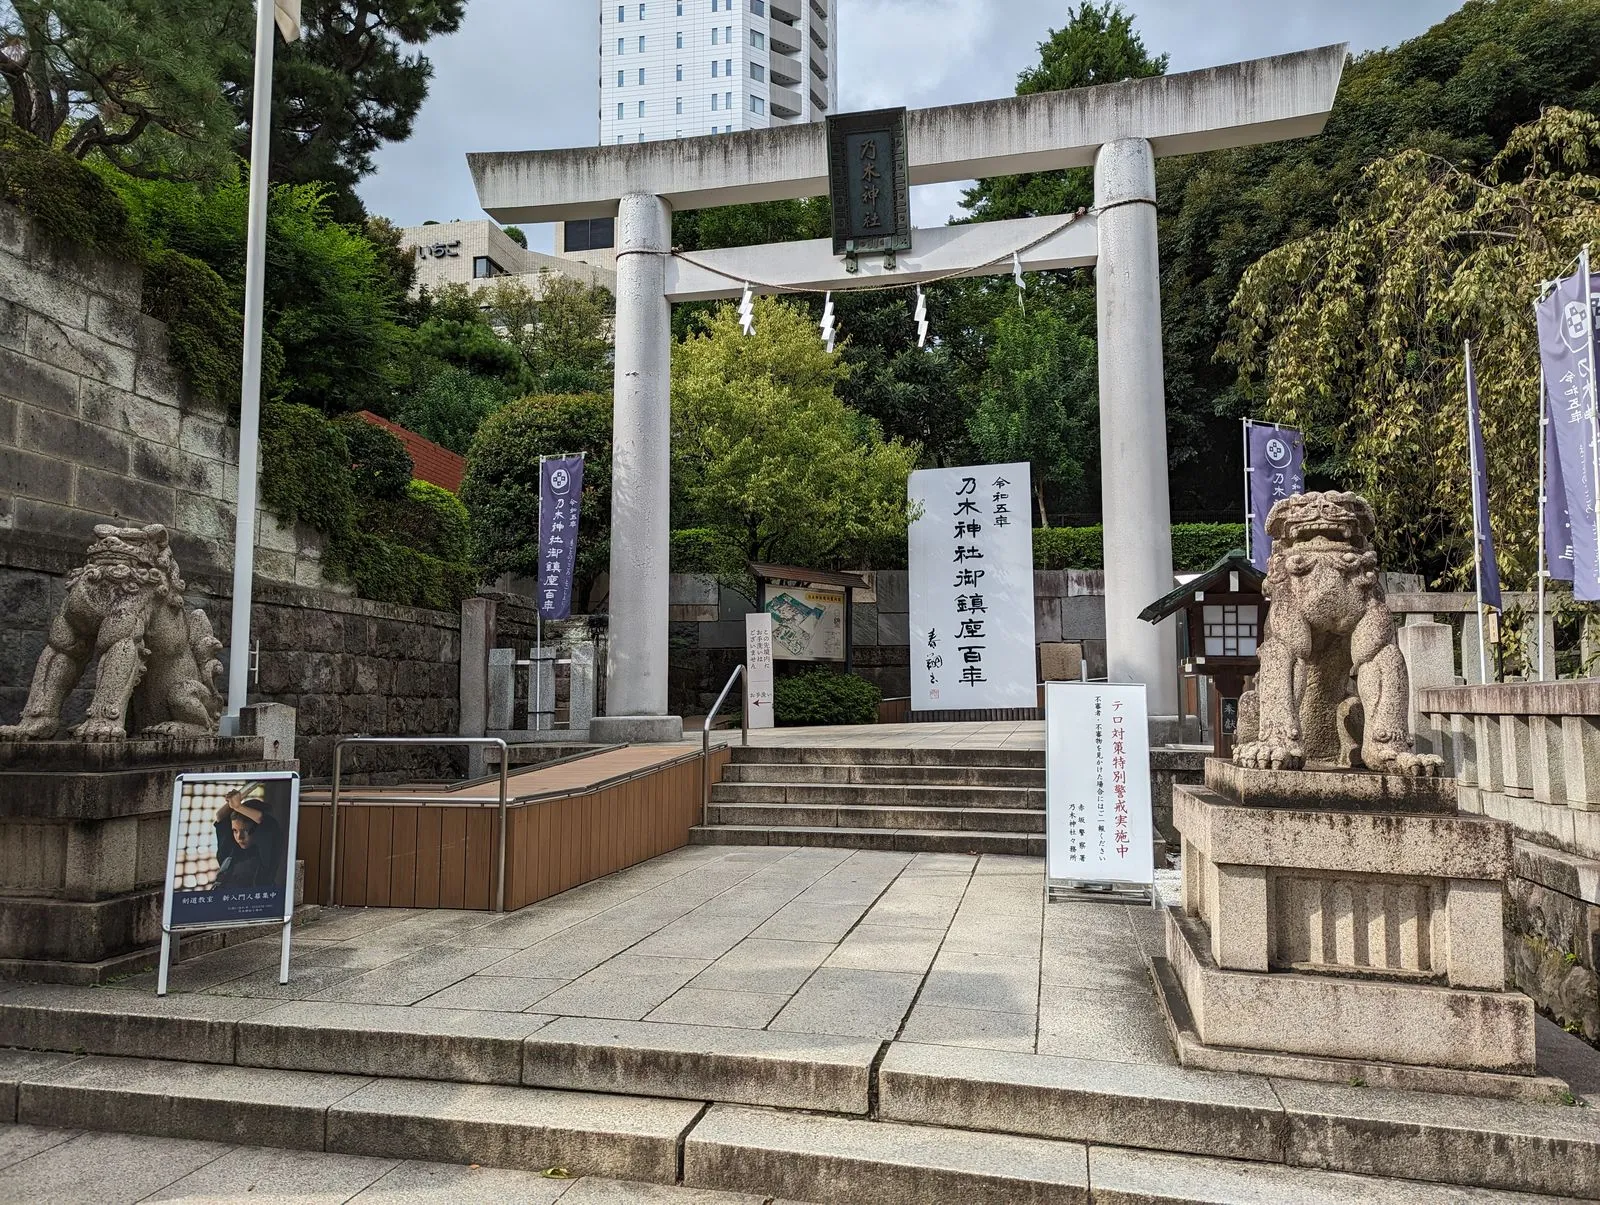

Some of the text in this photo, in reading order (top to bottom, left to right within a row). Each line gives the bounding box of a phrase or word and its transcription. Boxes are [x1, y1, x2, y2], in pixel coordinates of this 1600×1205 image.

[860, 139, 881, 228] 乃木神社
[417, 240, 461, 259] いちご
[569, 499, 578, 527] 令和五年
[991, 476, 1011, 528] 令和五年
[1291, 474, 1301, 494] 令和
[542, 499, 565, 611] 乃木神社御鎮座百年
[953, 477, 988, 687] 乃木神社御鎮座百年
[1111, 700, 1130, 859] テロ対策特別警戒実施中
[1068, 803, 1077, 862] 乃木神社々務所
[1078, 803, 1086, 862] 赤坂警察署
